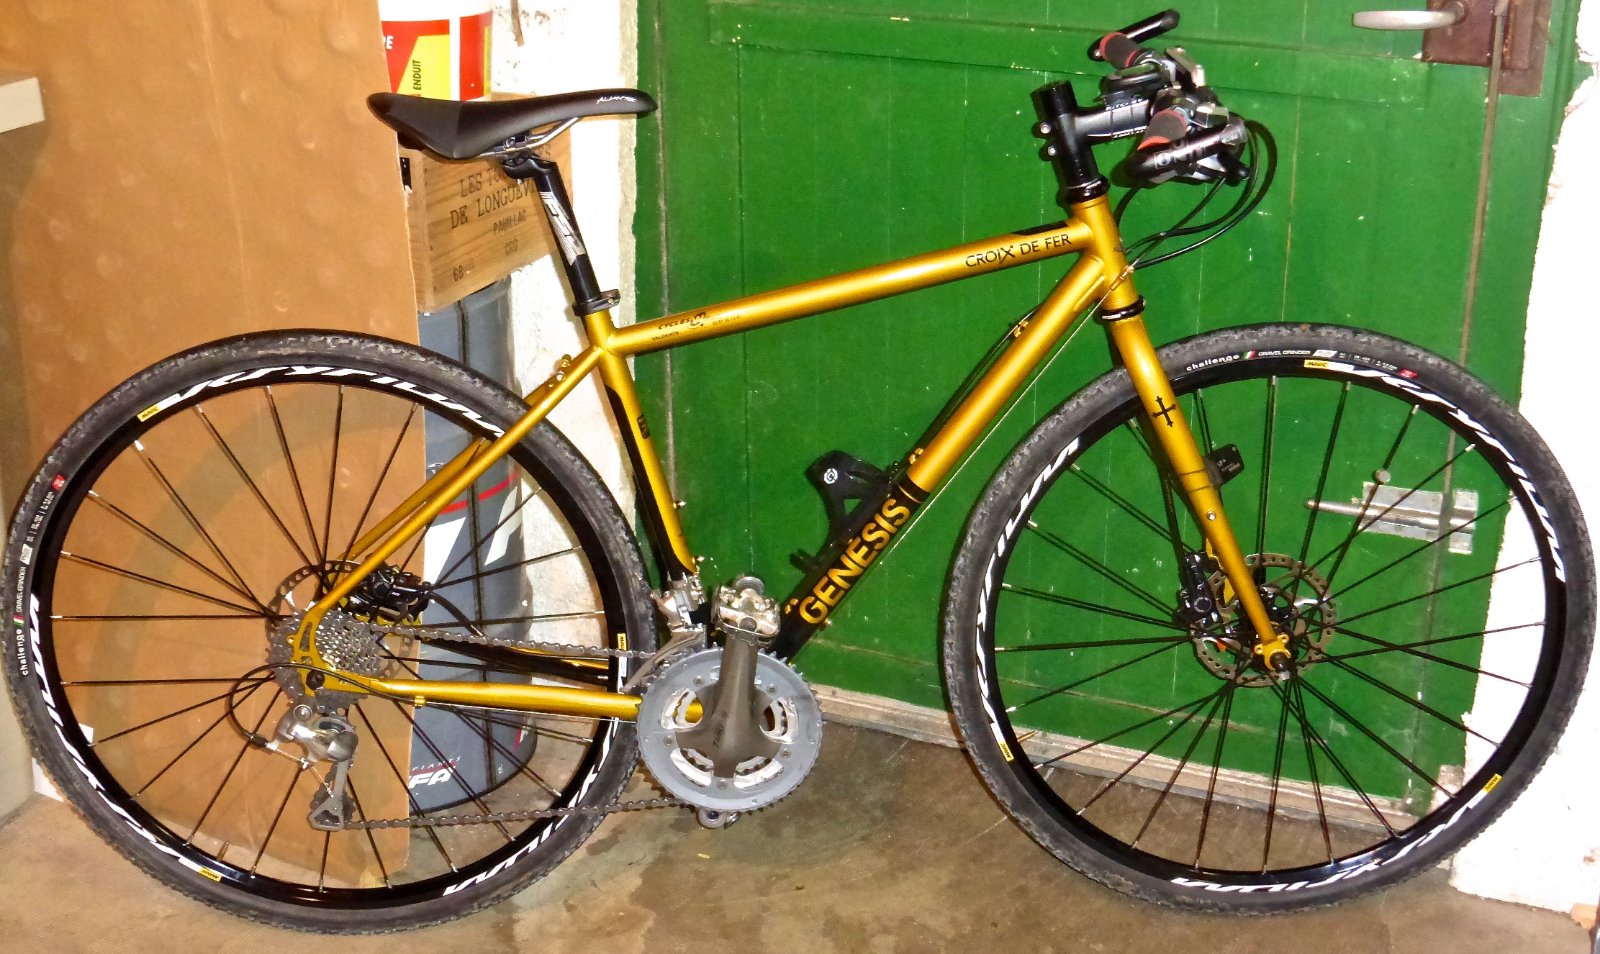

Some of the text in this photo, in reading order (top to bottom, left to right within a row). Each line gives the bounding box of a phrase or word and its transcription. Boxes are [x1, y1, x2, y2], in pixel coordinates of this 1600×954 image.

[412, 59, 422, 91] ENDUIT
[459, 172, 482, 198] LES
[450, 205, 468, 230] DE
[965, 233, 1073, 268] CROIX DE FER
[1186, 353, 1240, 372] challenge
[799, 497, 911, 625] GENESIS
[16, 628, 29, 677] challenge
